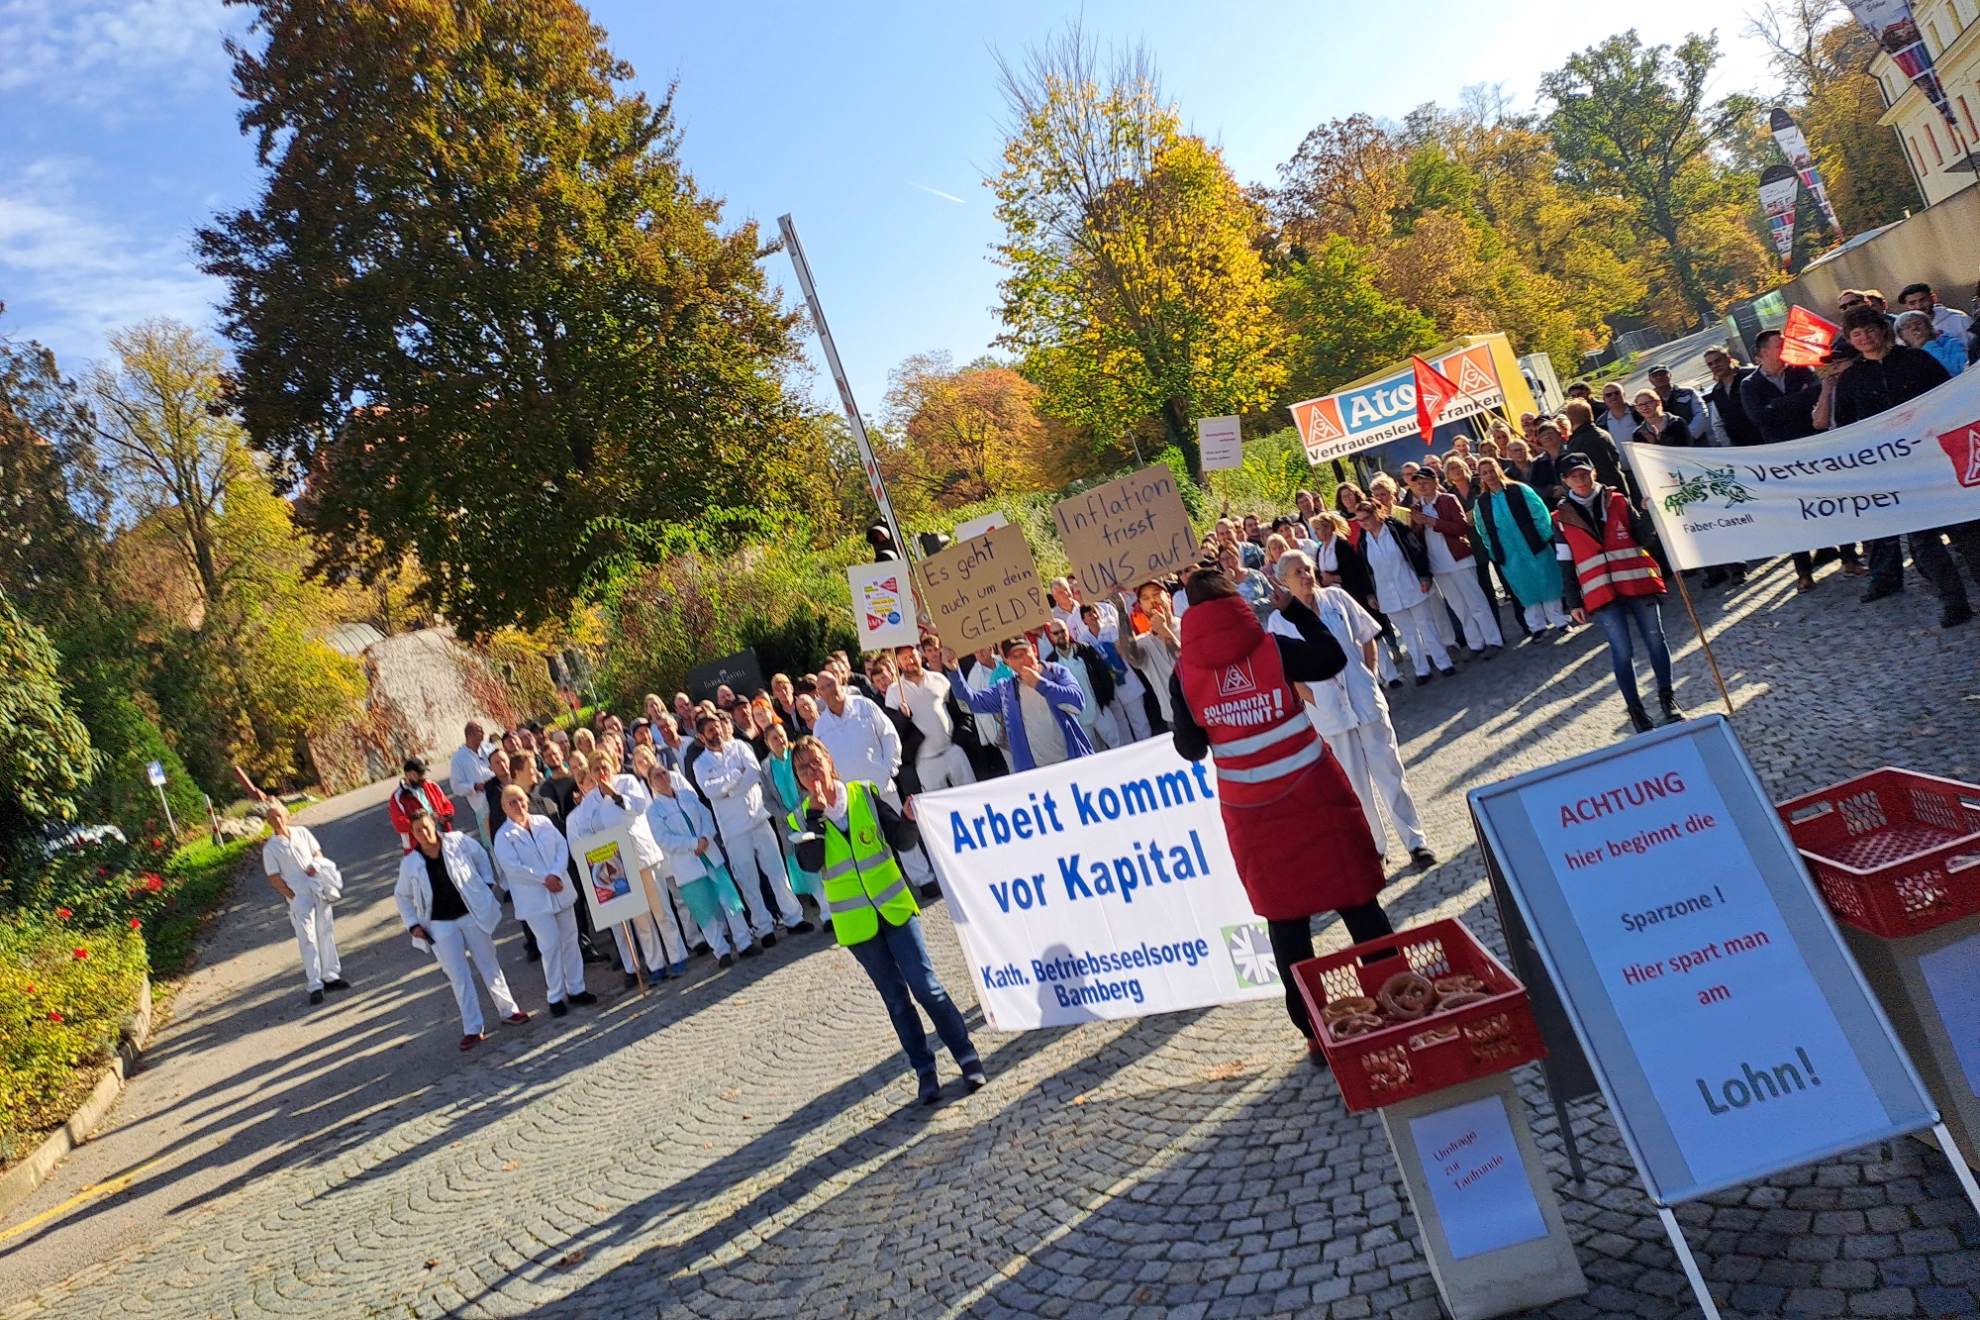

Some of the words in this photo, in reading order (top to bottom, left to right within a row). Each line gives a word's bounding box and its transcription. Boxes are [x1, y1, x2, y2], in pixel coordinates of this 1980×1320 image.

[1745, 436, 1922, 483] Vertrauens-
[1058, 478, 1171, 535] Inflation
[1683, 513, 1754, 534] Faber-Castell
[1799, 489, 1902, 521] körper
[1102, 509, 1157, 547] frisst
[922, 562, 949, 587] Es
[957, 536, 994, 581] geht
[1080, 551, 1135, 595] UNS
[941, 588, 970, 615] auch
[976, 583, 997, 599] um
[1003, 564, 1032, 587] dein
[1203, 692, 1270, 720] SOLIDARITÄT
[949, 790, 1065, 854] Arbeit
[1070, 760, 1215, 826] kommt
[1560, 771, 1686, 828] ACHTUNG
[1564, 847, 1604, 870] hier
[1605, 822, 1683, 858] beginnt
[1685, 812, 1717, 834] die
[988, 872, 1047, 914] vor
[1057, 830, 1211, 903] Kapital
[1620, 894, 1713, 933] Sparzone
[980, 963, 1031, 990] Kath.
[1031, 937, 1210, 983] Betriebsseelsorge
[1622, 962, 1665, 986] Hier
[1668, 942, 1722, 974] spart
[1723, 930, 1771, 956] man
[1053, 976, 1145, 1009] Bamberg
[1697, 984, 1732, 1006] am
[1696, 1046, 1822, 1116] Lohn!
[1433, 1131, 1478, 1162] Umfrage
[1444, 1161, 1461, 1176] zur
[1453, 1155, 1505, 1191] Tarifrunde
